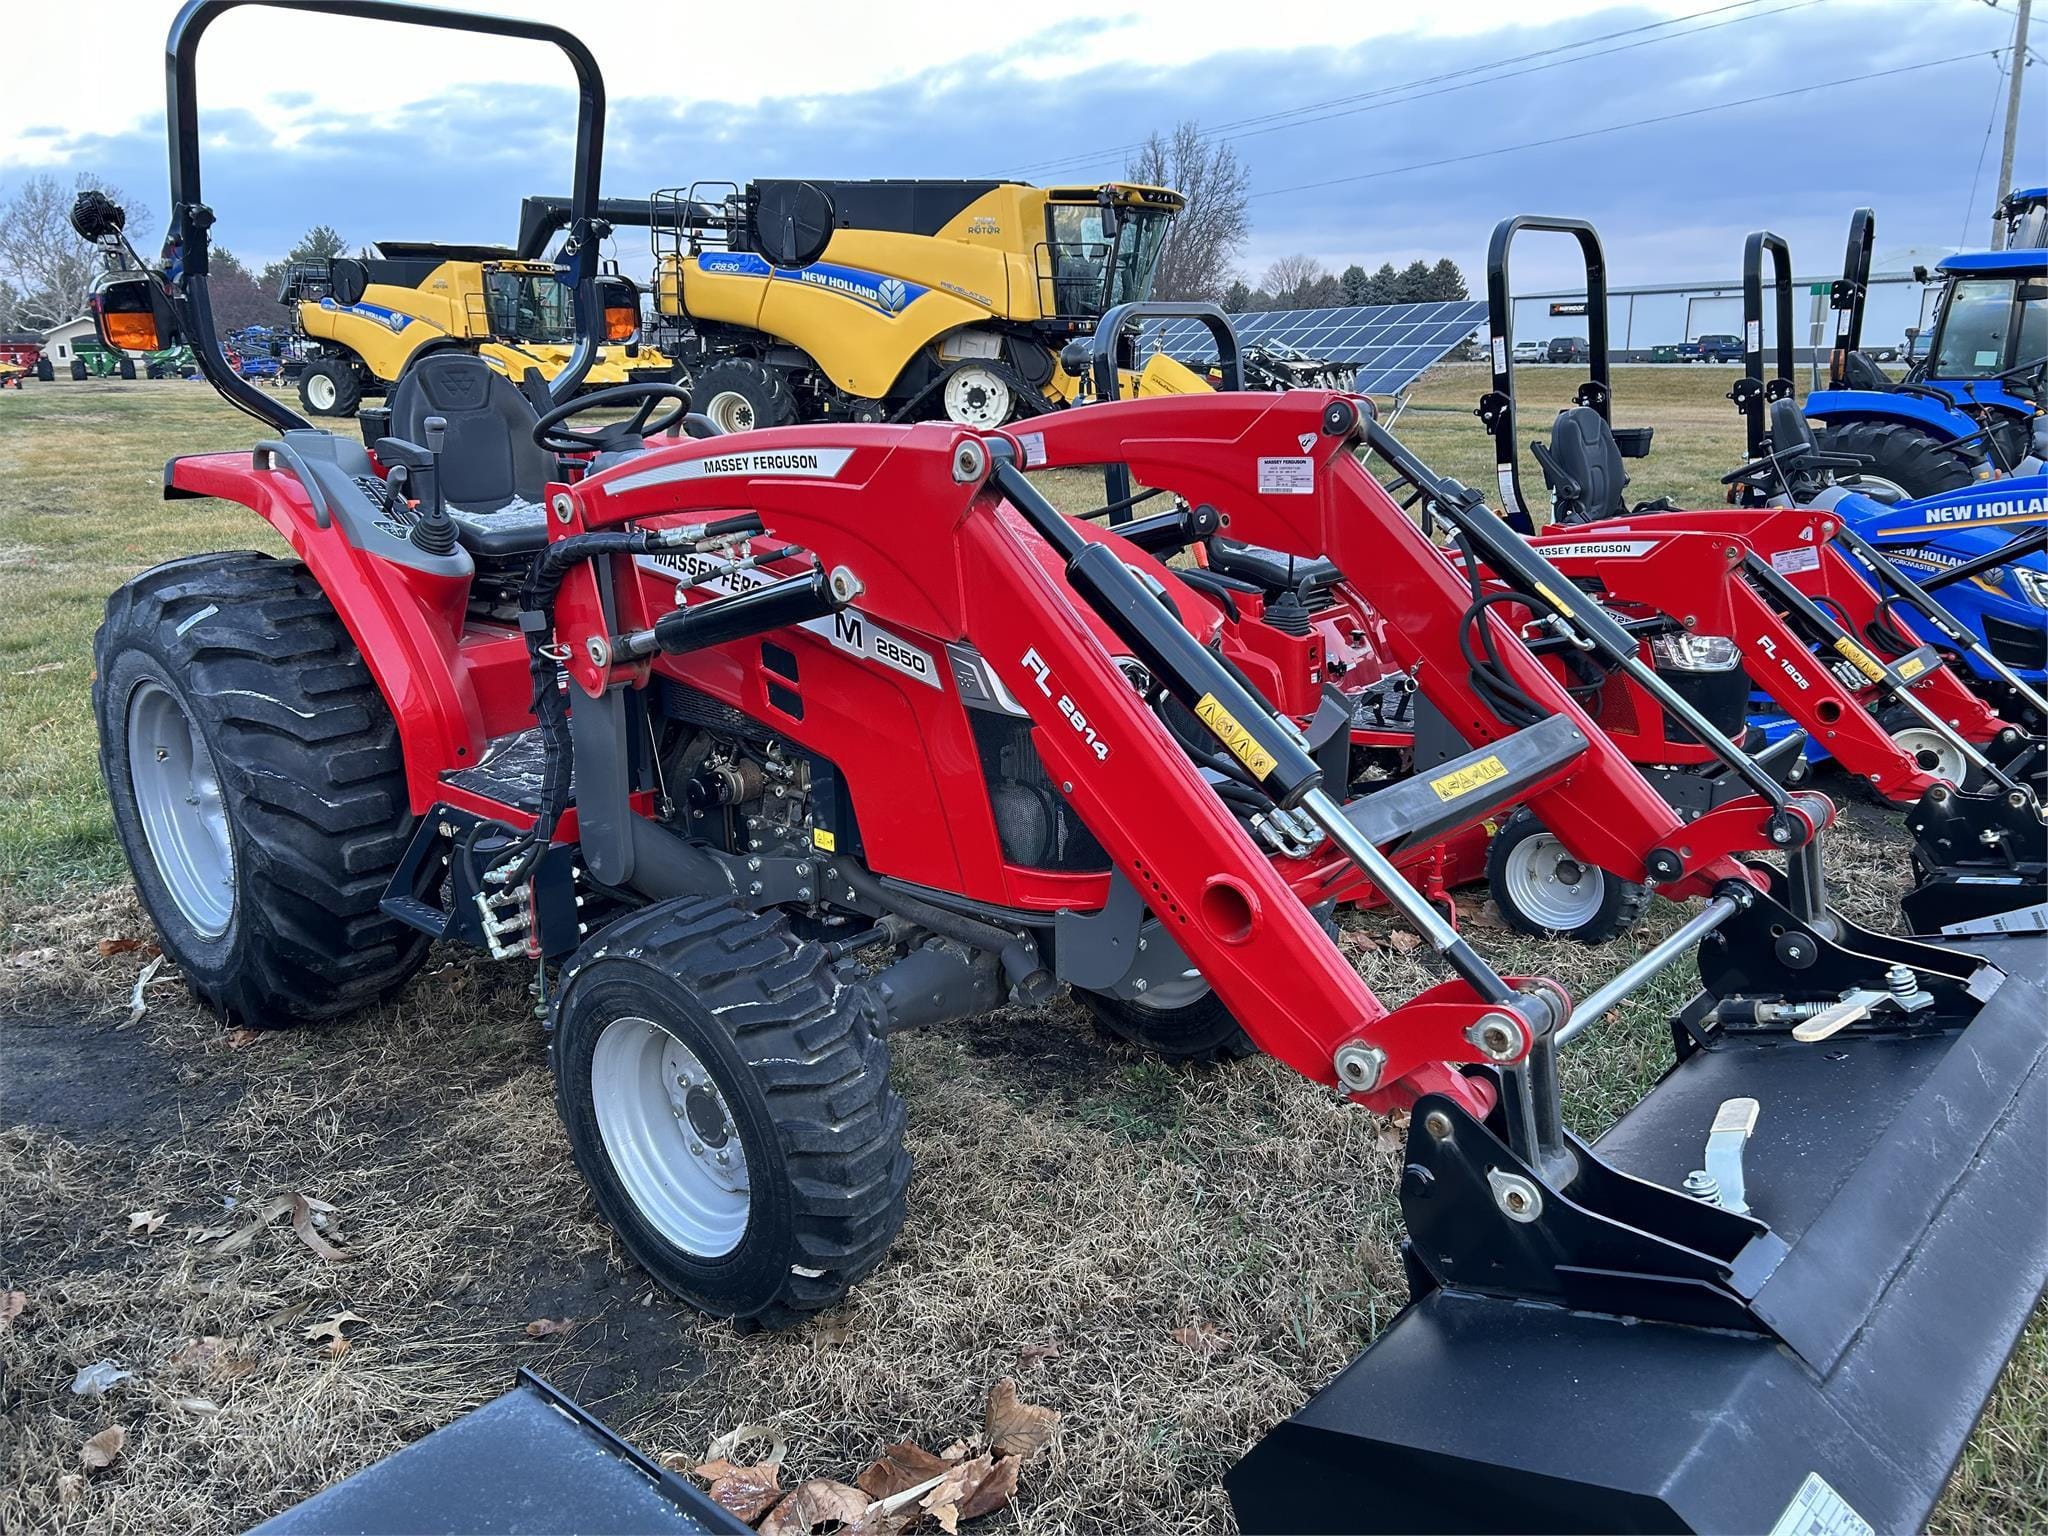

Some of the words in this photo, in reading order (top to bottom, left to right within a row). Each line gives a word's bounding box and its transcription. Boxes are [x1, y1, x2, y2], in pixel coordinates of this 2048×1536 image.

[801, 270, 827, 284] NEW
[828, 276, 878, 300] HOLLAND
[704, 457, 750, 474] MASSEY
[753, 454, 818, 470] FERGUSON
[1926, 505, 1972, 523] NEW
[1535, 546, 1571, 556] ASSEY
[1574, 544, 1631, 555] FERGUSON
[1888, 556, 1936, 573] WORKMASTER
[834, 612, 863, 649] M
[875, 638, 926, 675] 2850
[1756, 635, 1777, 660] FL
[1021, 647, 1052, 698] FL
[1057, 695, 1108, 760] 2814
